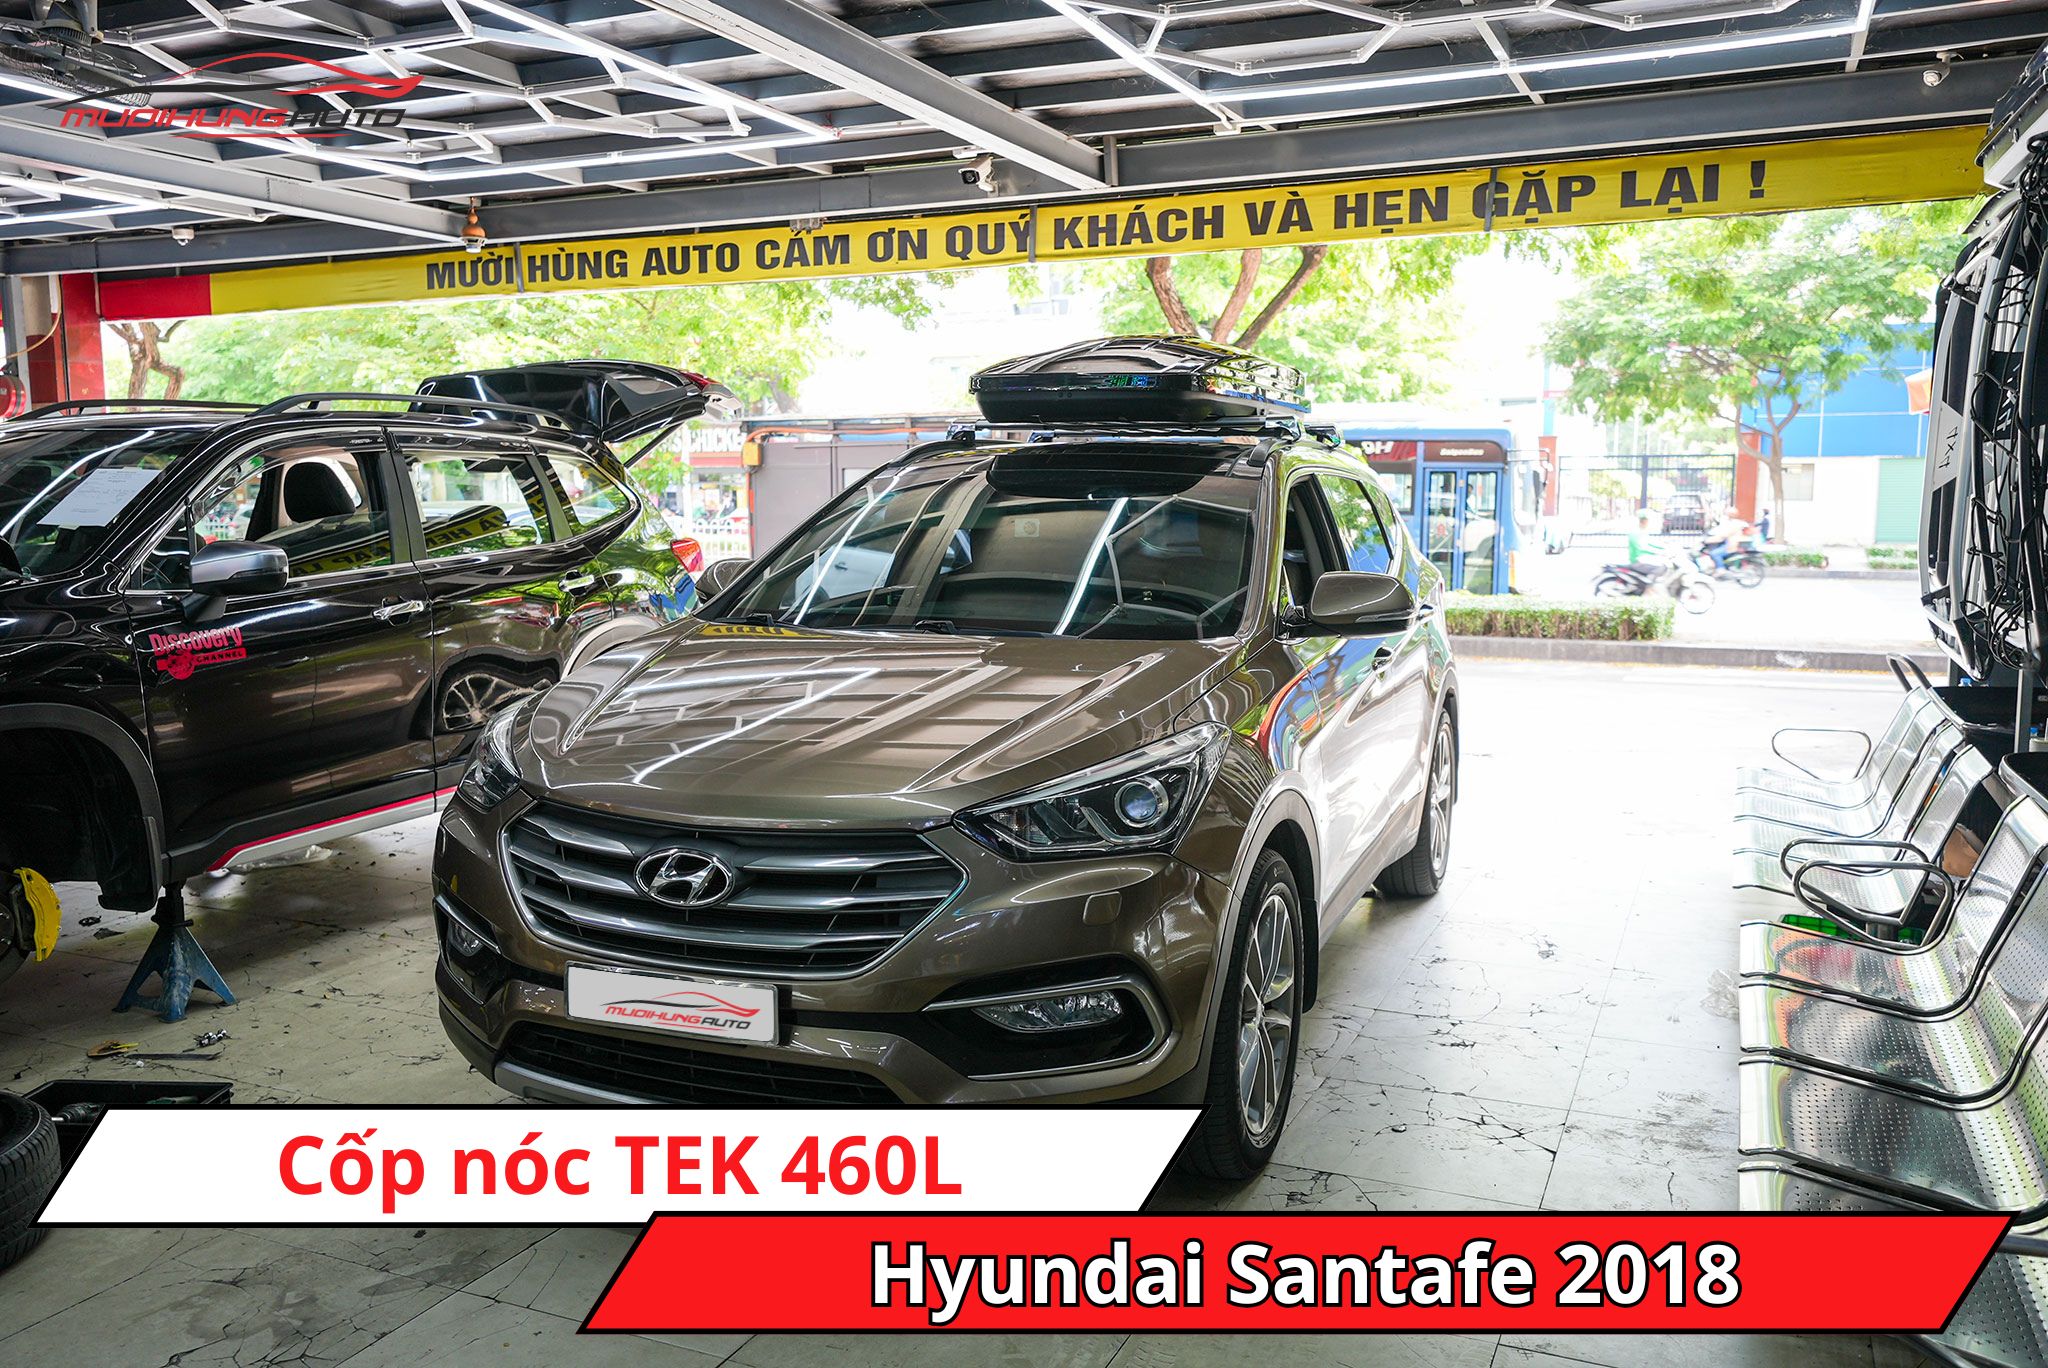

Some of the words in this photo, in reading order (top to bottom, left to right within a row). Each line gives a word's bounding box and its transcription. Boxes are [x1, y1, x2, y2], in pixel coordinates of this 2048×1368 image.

[426, 251, 515, 290] MƯỜI
[527, 247, 629, 283] HÙNG
[641, 242, 740, 277] AUTO
[867, 227, 928, 263] ƠN
[945, 213, 1032, 260] QUÝ
[1053, 203, 1224, 250] KHÁCH
[1243, 190, 1314, 236] VÀ
[1333, 185, 1450, 234] HẸN
[1471, 169, 1596, 224] GẶP
[1620, 163, 1720, 214] LẠI
[196, 650, 243, 662] CHANNEL
